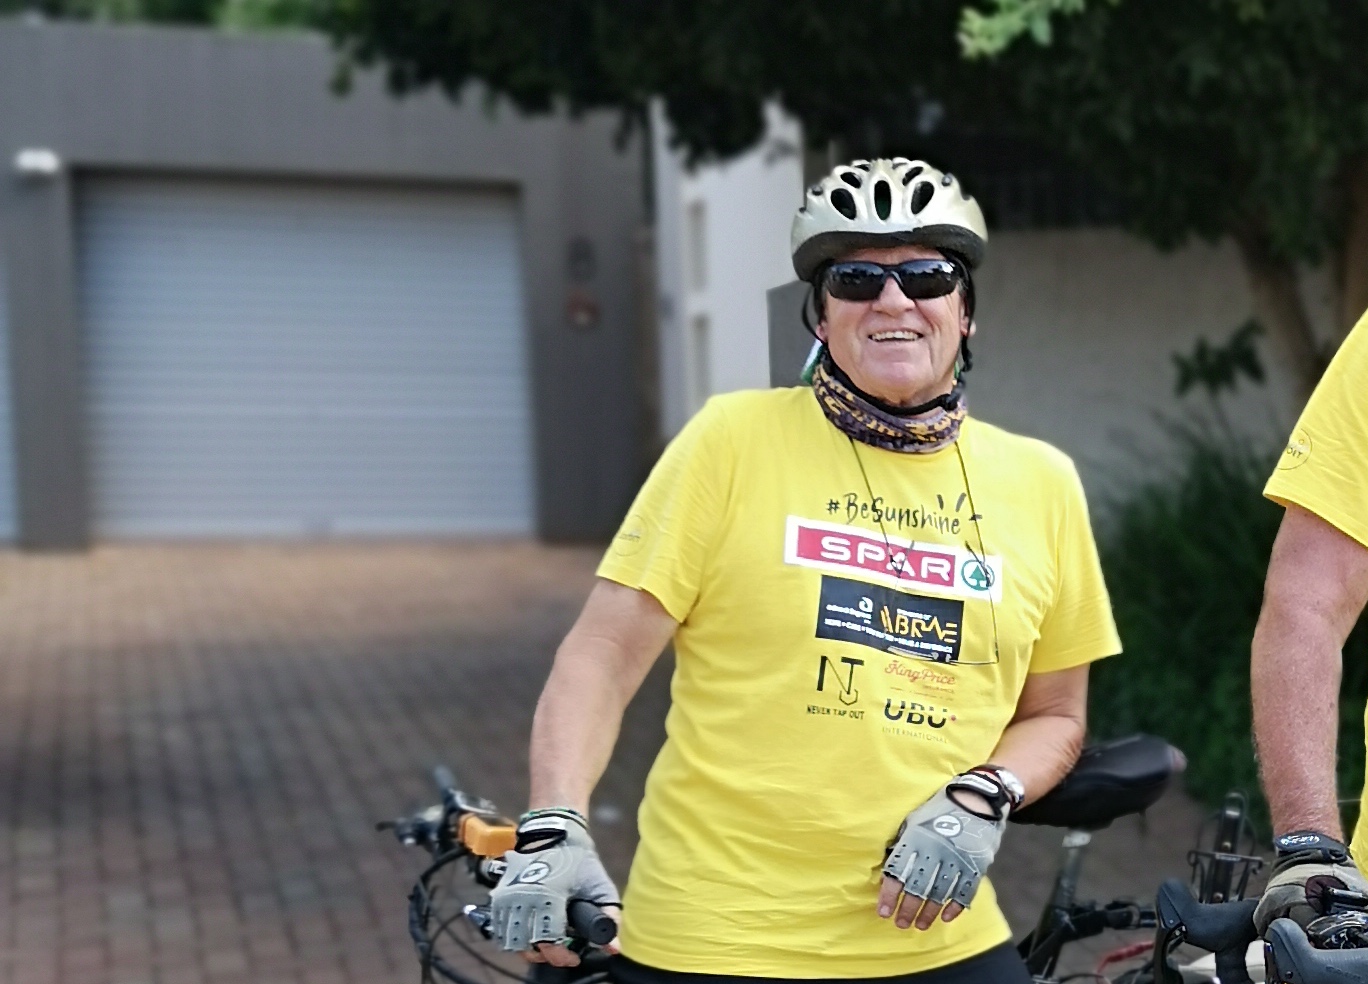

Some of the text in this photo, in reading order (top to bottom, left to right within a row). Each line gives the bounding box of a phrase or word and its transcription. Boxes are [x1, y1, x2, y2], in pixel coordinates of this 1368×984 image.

[826, 492, 961, 535] #BeSunshine
[820, 535, 952, 581] SPAR
[884, 660, 957, 685] King Price
[806, 704, 865, 721] NEVER TAP OUT
